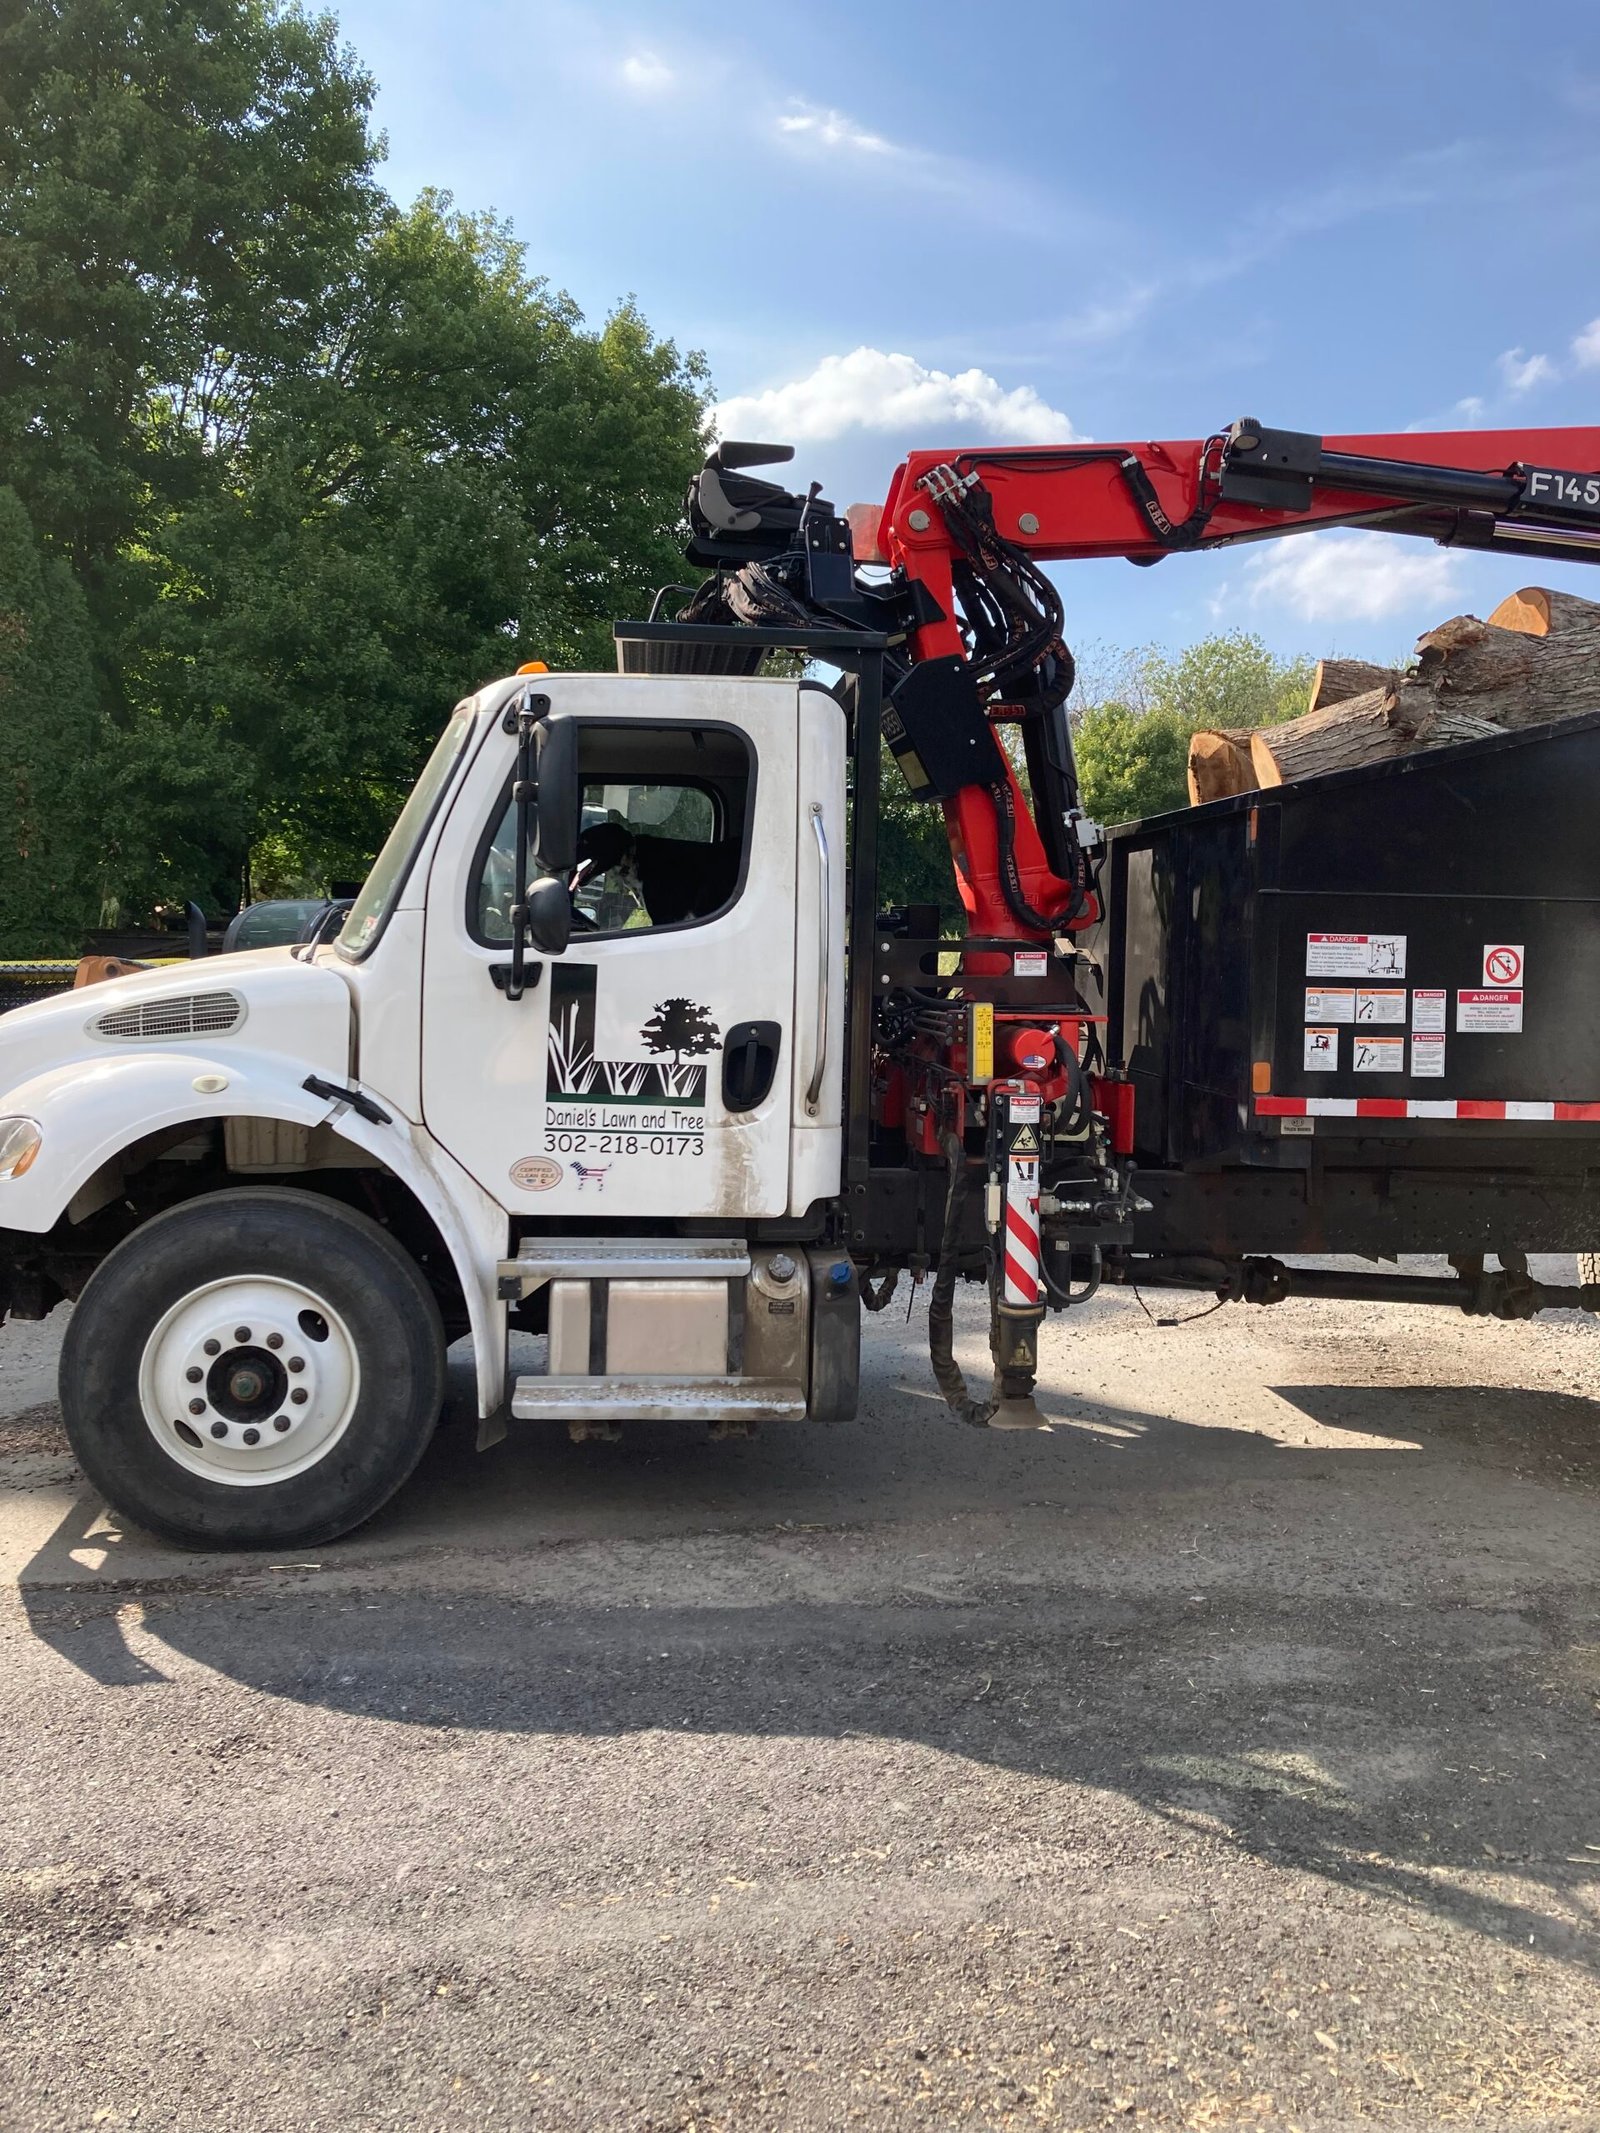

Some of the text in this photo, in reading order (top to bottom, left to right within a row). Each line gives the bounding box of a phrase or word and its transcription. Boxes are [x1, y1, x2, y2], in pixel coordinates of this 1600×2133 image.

[1531, 472, 1600, 505] F145
[546, 1106, 704, 1130] Daniel's Lawn and Tree
[544, 1133, 704, 1156] 302-218-0173
